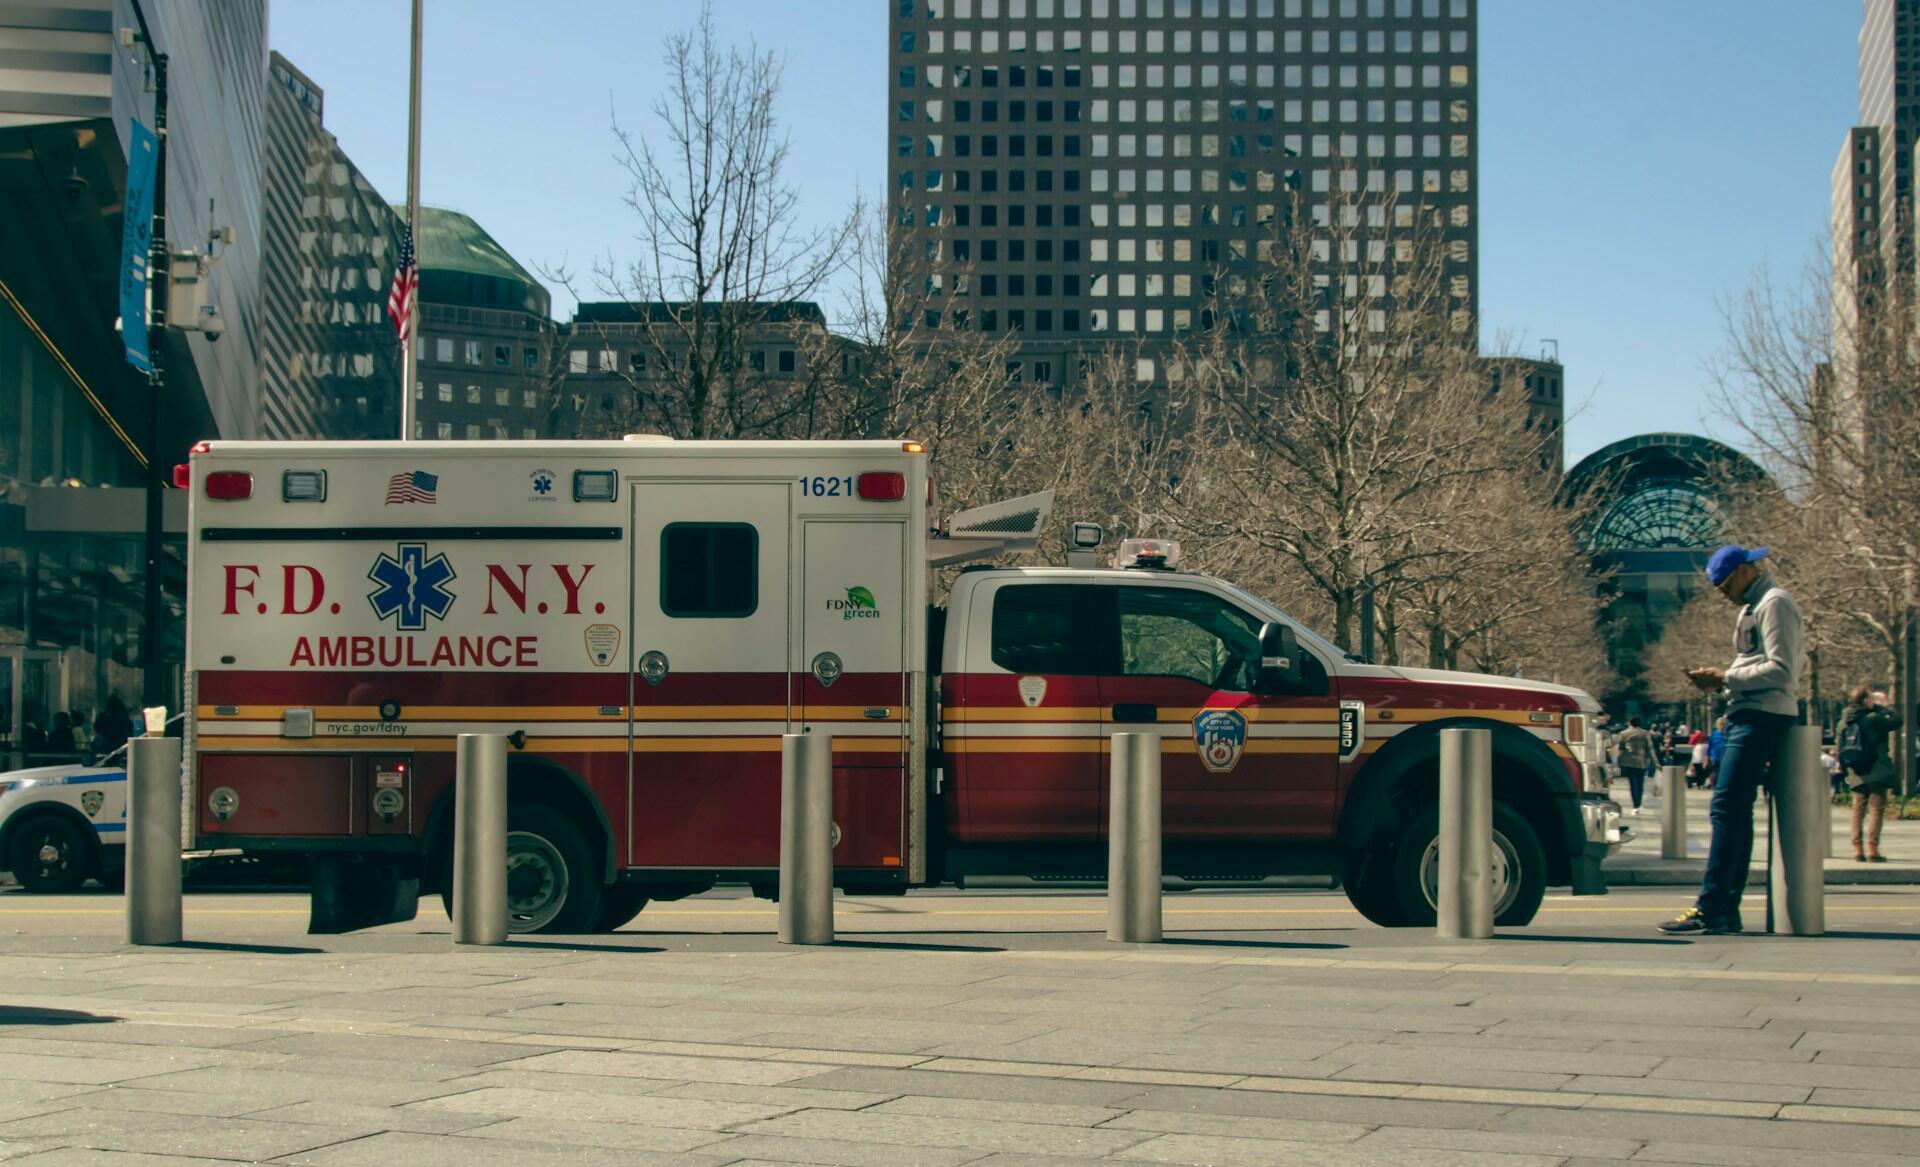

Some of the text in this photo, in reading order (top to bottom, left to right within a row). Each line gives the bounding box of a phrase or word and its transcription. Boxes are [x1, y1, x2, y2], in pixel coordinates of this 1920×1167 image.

[800, 476, 852, 497] 1621
[826, 599, 863, 610] FDNY
[843, 609, 880, 621] green
[289, 635, 539, 667] AMBULANCE
[327, 721, 408, 736] nyc.gov/fdny
